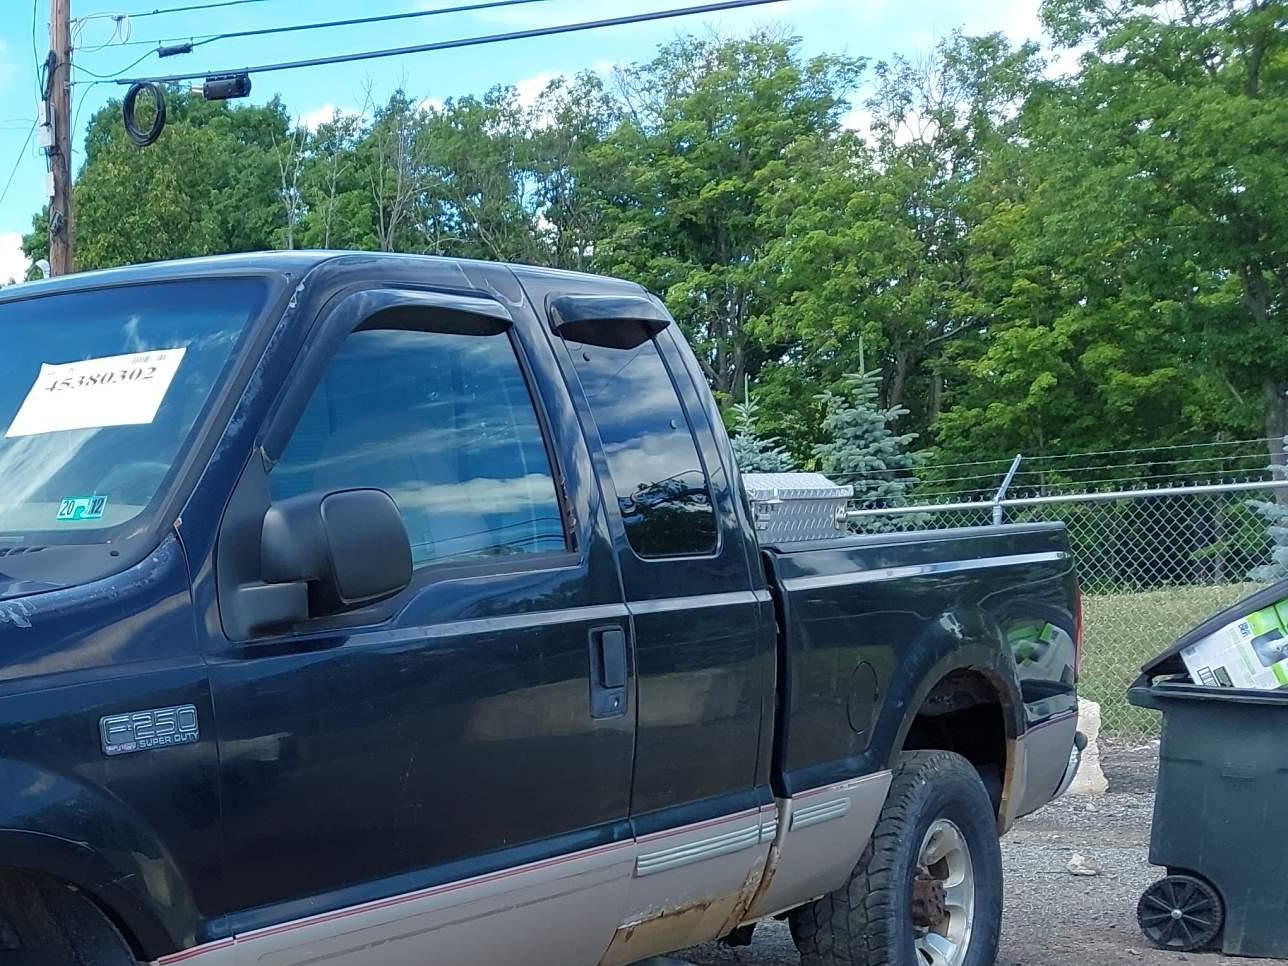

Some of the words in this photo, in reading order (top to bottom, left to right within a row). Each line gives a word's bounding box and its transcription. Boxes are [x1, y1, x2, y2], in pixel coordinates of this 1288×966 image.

[45, 367, 157, 392] 45380302
[59, 500, 75, 516] 20
[91, 498, 104, 514] 12
[103, 705, 198, 745] F-250
[140, 736, 172, 748] SUPER
[174, 731, 199, 743] DUTY
